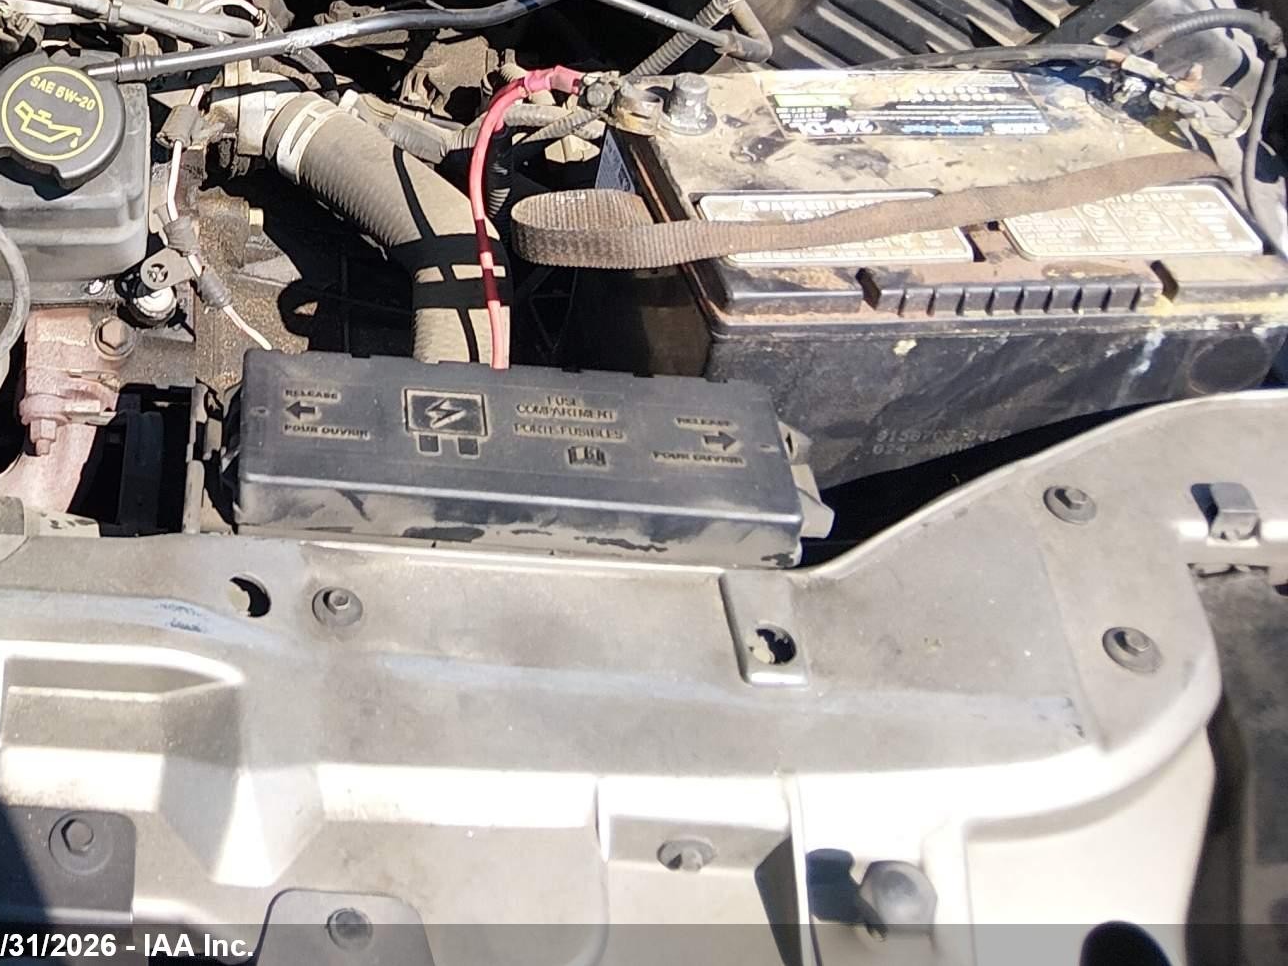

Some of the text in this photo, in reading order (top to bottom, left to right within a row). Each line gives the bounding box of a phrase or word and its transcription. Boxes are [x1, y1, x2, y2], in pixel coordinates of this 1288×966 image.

[30, 75, 56, 94] SAE
[285, 389, 339, 400] RELEASE
[284, 423, 318, 433] POUR
